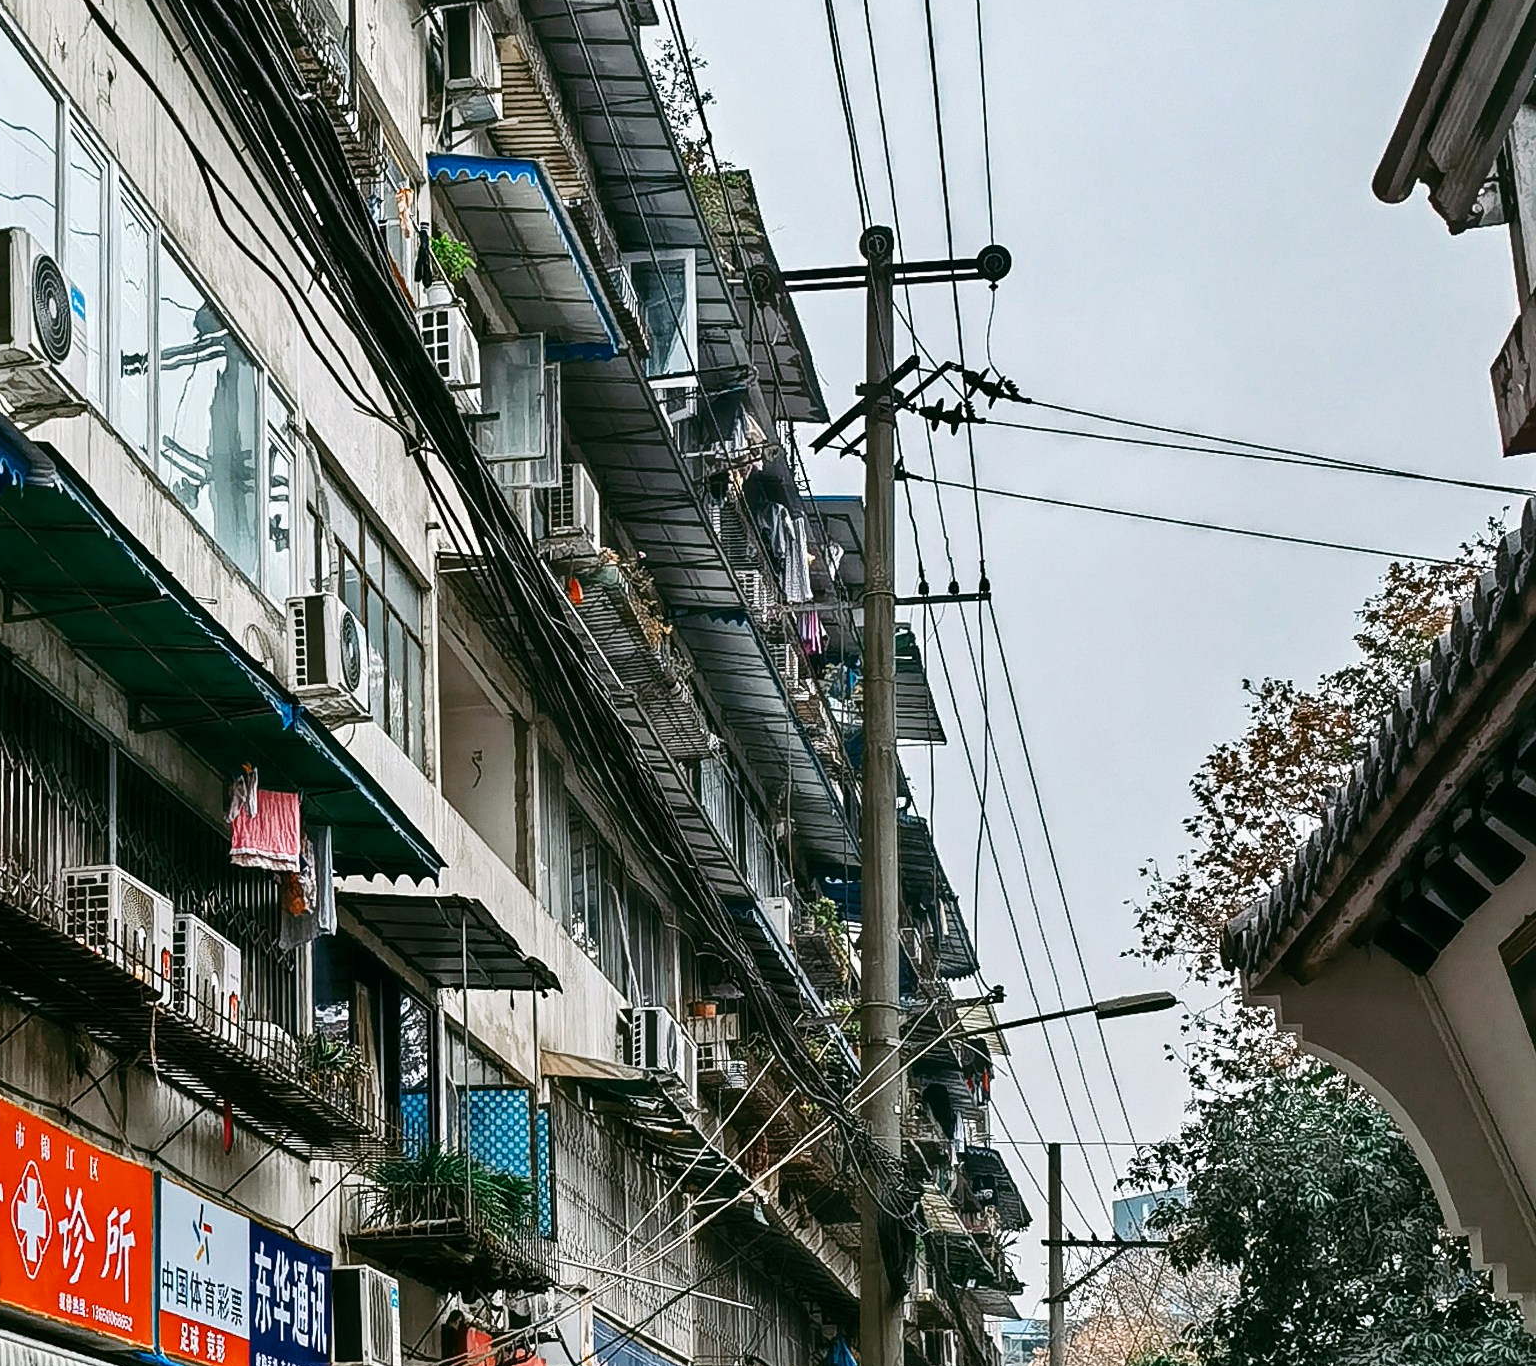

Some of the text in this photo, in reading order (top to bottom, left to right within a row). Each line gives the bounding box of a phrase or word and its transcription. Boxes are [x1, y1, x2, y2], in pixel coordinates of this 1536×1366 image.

[58, 1187, 136, 1304] 诊所
[162, 1260, 243, 1327] 中国体育彩票
[254, 1241, 328, 1355] 东华通讯
[179, 1323, 200, 1356] 足球
